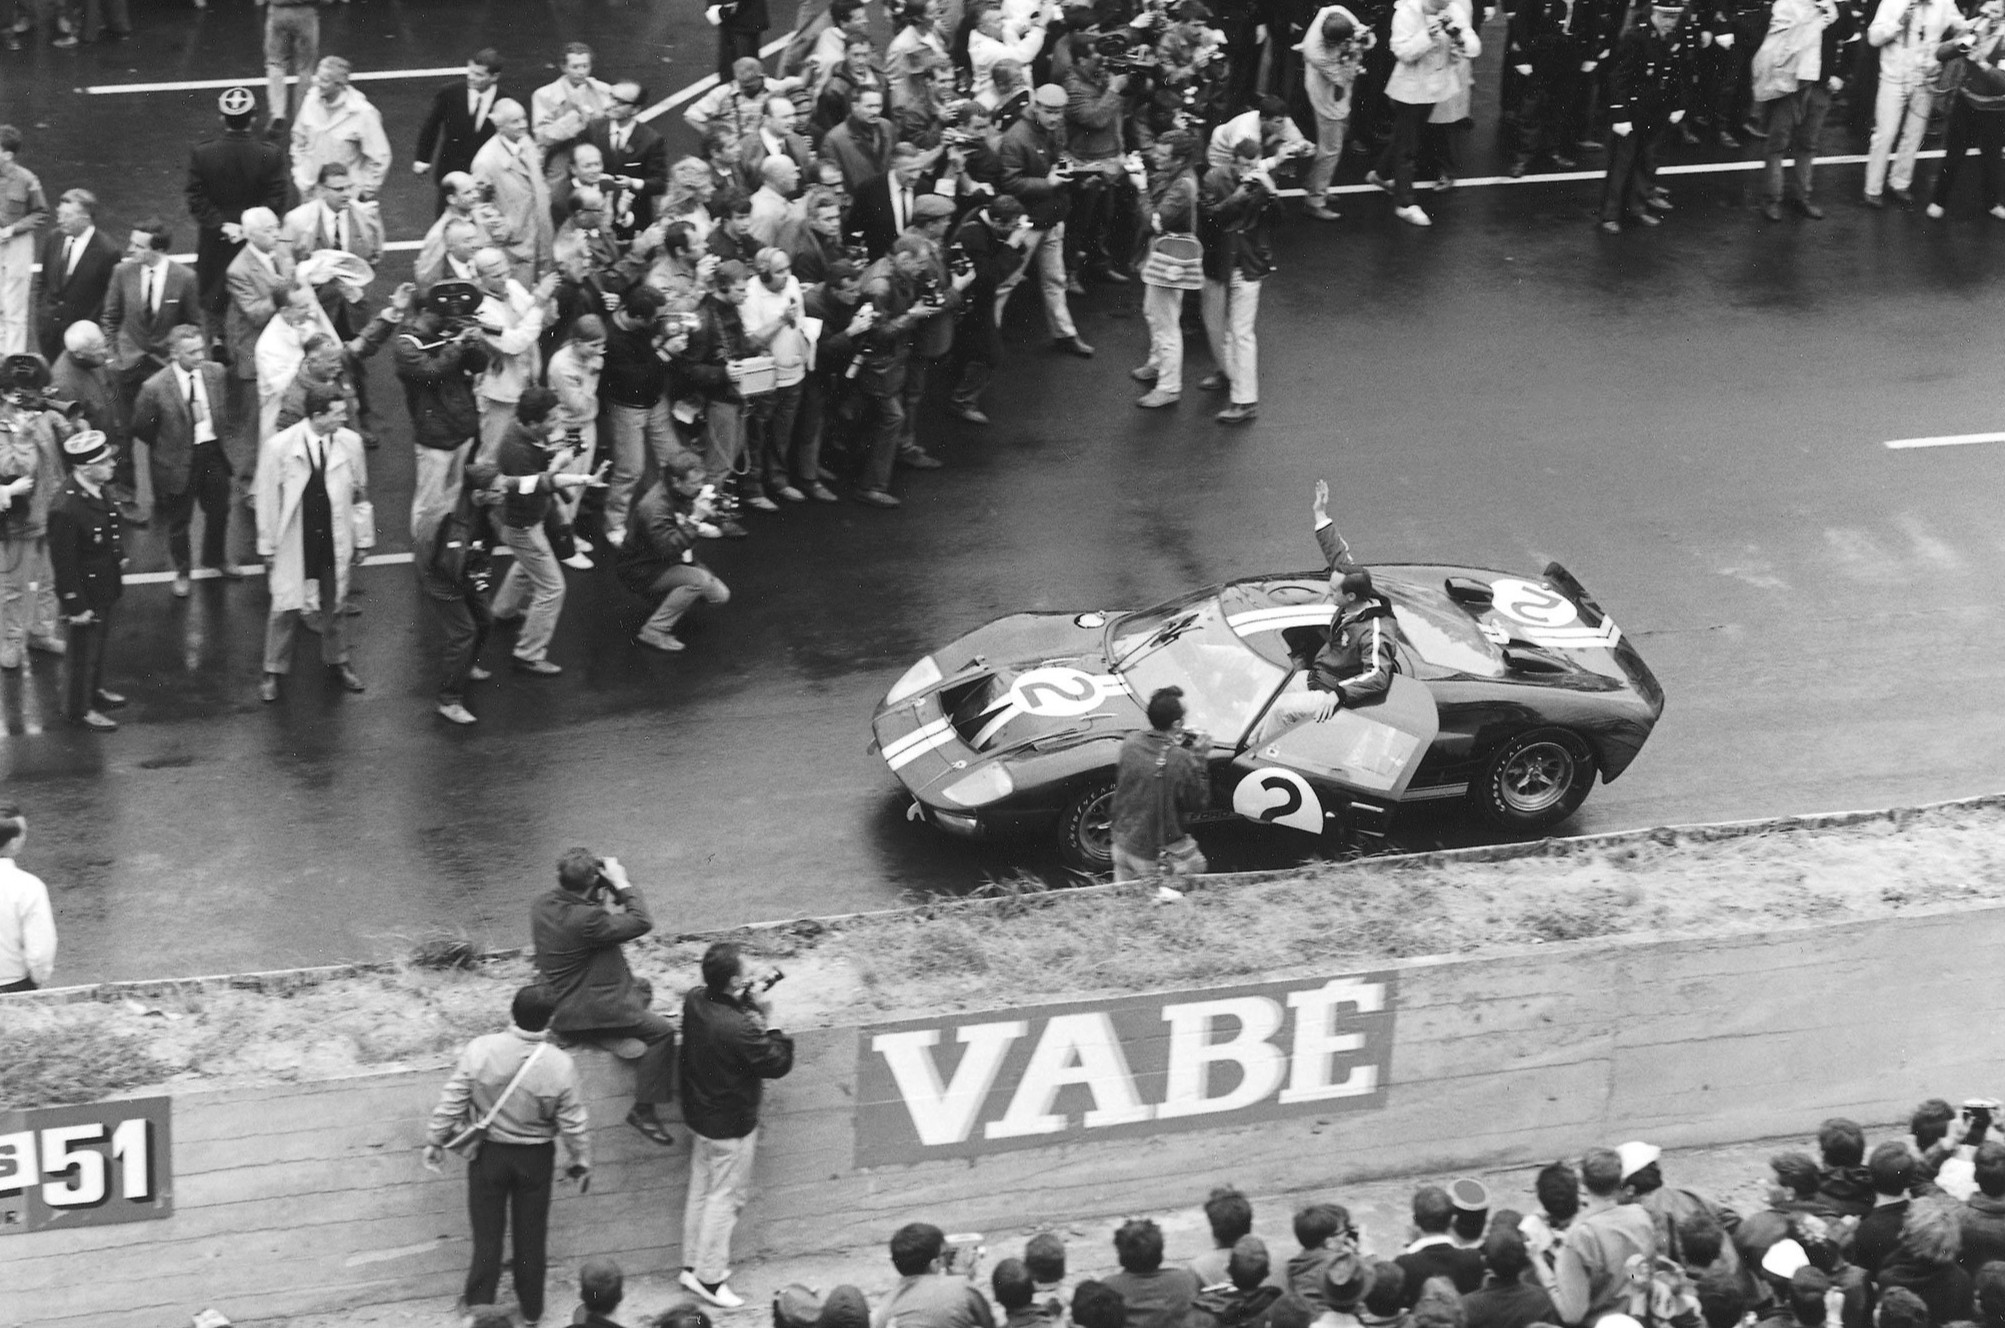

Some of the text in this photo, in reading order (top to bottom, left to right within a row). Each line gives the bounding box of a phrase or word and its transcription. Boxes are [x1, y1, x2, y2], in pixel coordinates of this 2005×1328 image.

[1510, 585, 1562, 623] 2
[1019, 676, 1095, 709] 2
[1260, 775, 1303, 824] 2
[41, 1118, 150, 1208] 51
